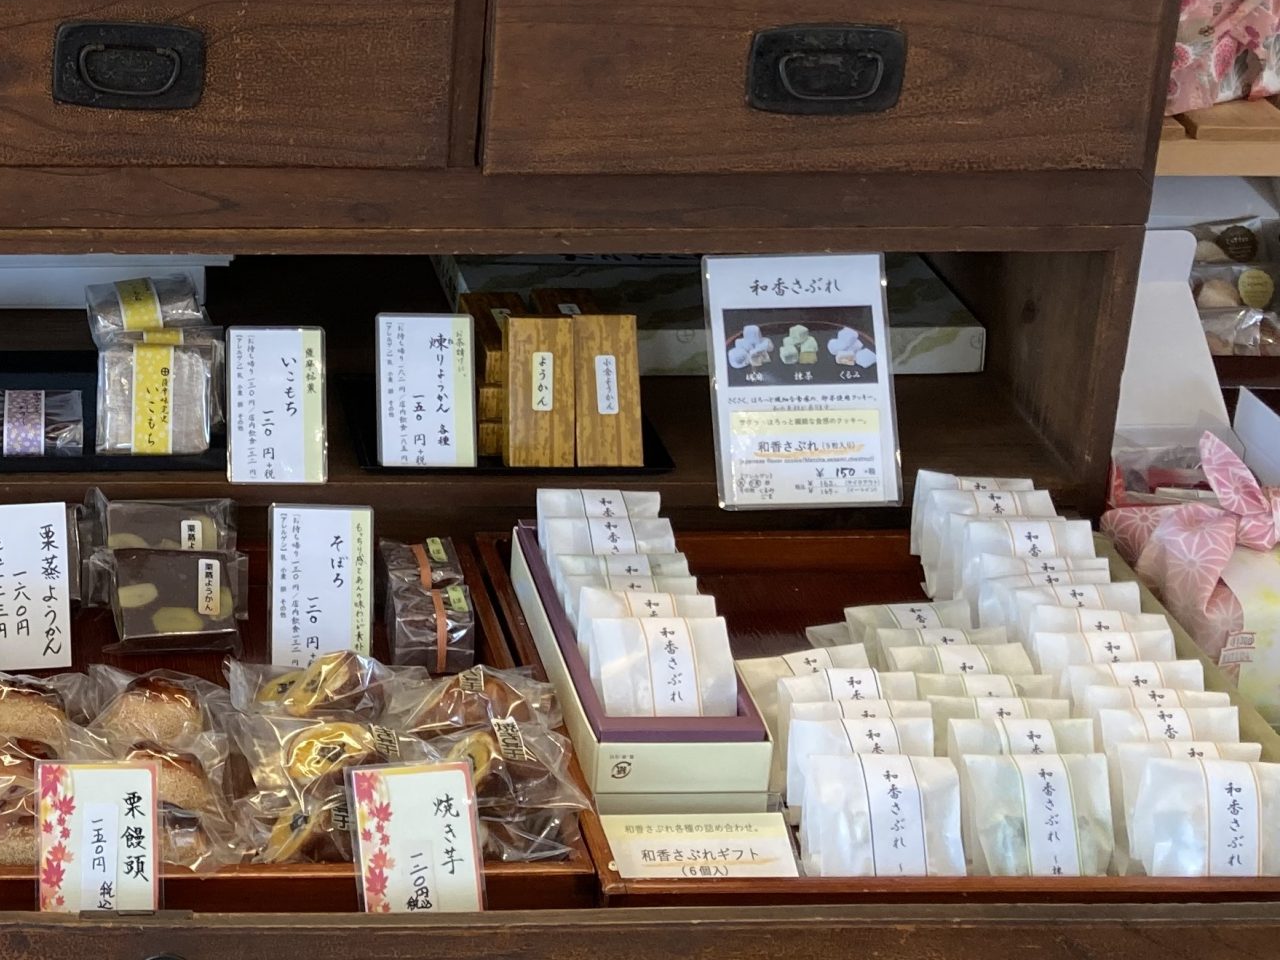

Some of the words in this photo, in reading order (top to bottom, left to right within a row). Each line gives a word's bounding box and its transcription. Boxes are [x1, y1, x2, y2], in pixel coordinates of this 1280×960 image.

[750, 277, 842, 297] 和香さぶれ
[281, 357, 298, 417] いこもち
[305, 348, 317, 394] 薩摩銘菓
[537, 356, 549, 407] ようかん
[146, 386, 158, 446] いこもち
[438, 424, 450, 447] 各種
[758, 440, 819, 453] 和香さぶれ
[835, 468, 856, 477] 150
[39, 523, 62, 656] 栗蒸ようかん
[659, 626, 684, 703] 和香さぶれ
[433, 793, 465, 875] 焼き芋
[624, 822, 760, 834] 和香さぶれ各種の詰め合わせ。
[883, 769, 907, 849] 和香さぶれ
[1038, 768, 1061, 843] 和香さぶれ
[1224, 781, 1244, 866] 和香さぶれ
[121, 791, 150, 882] 栗饅頭
[641, 848, 760, 863] 和香さぶれギフト
